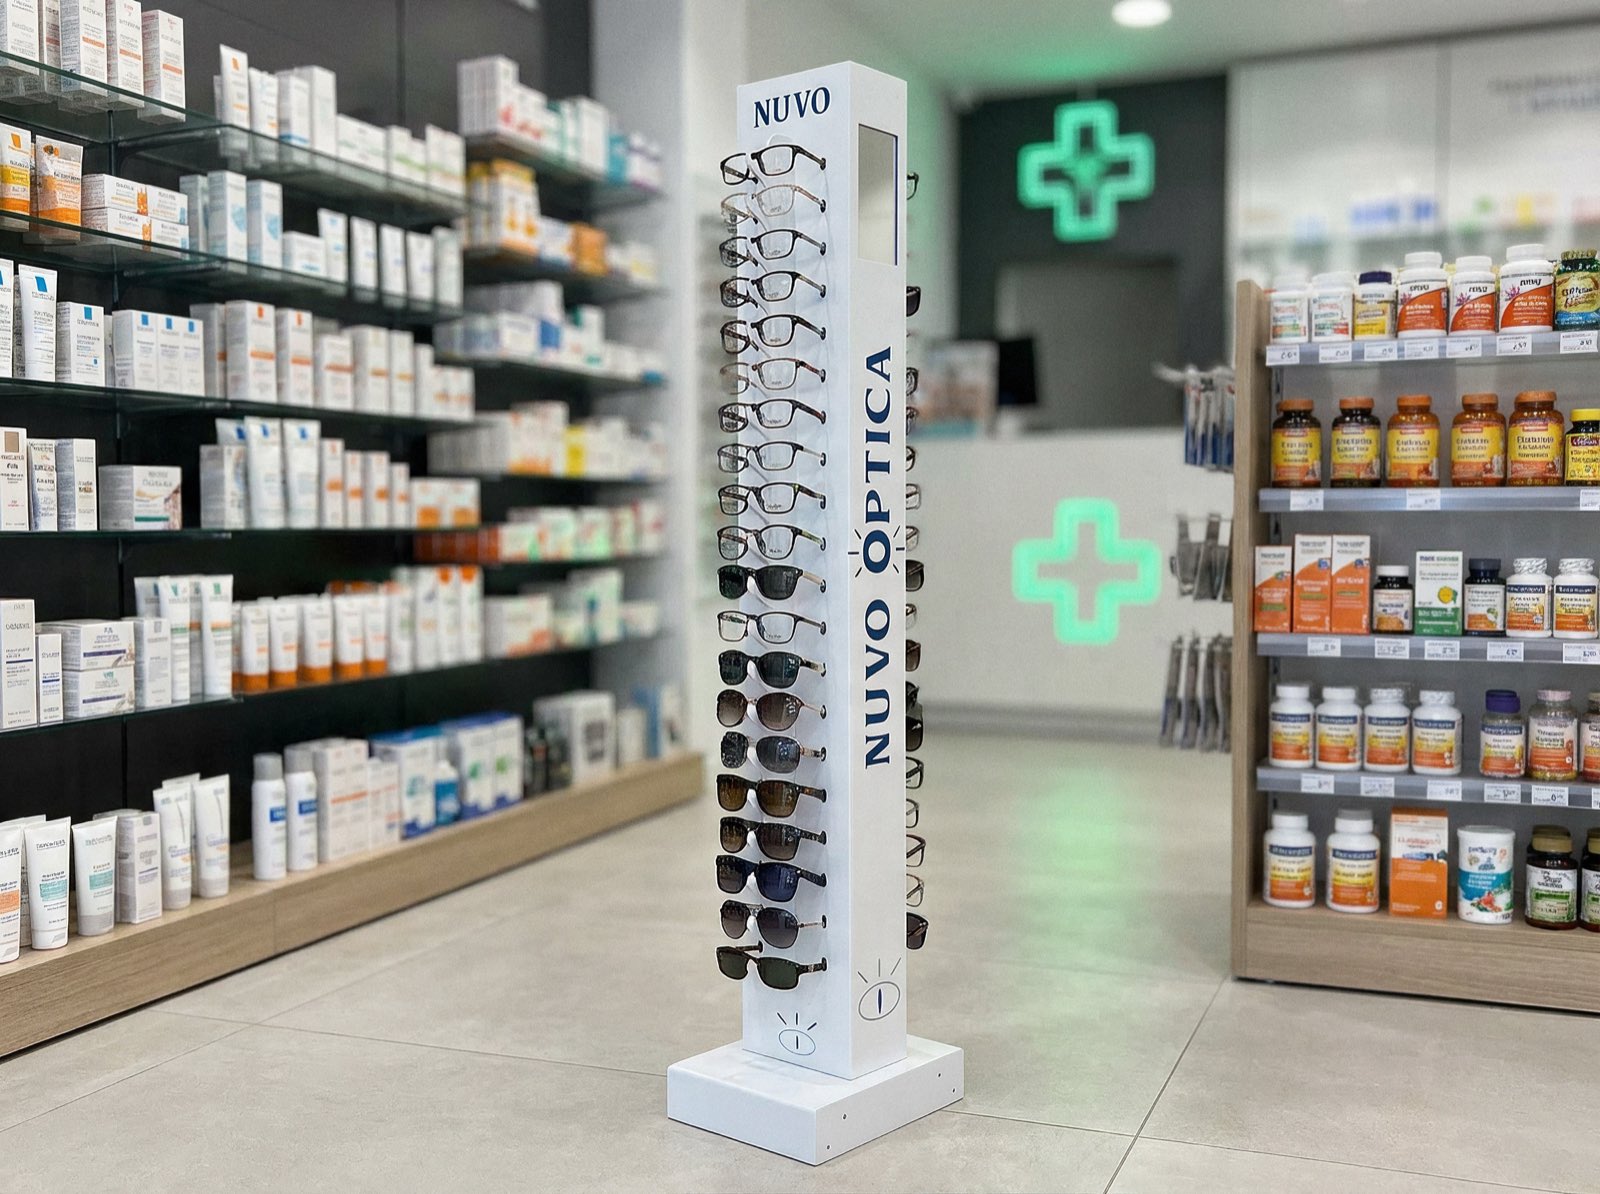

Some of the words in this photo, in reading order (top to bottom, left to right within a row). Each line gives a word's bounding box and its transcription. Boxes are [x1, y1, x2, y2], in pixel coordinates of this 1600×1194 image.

[753, 86, 831, 128] NUVO
[863, 346, 891, 574] OPTICA
[865, 599, 891, 769] NUVO
